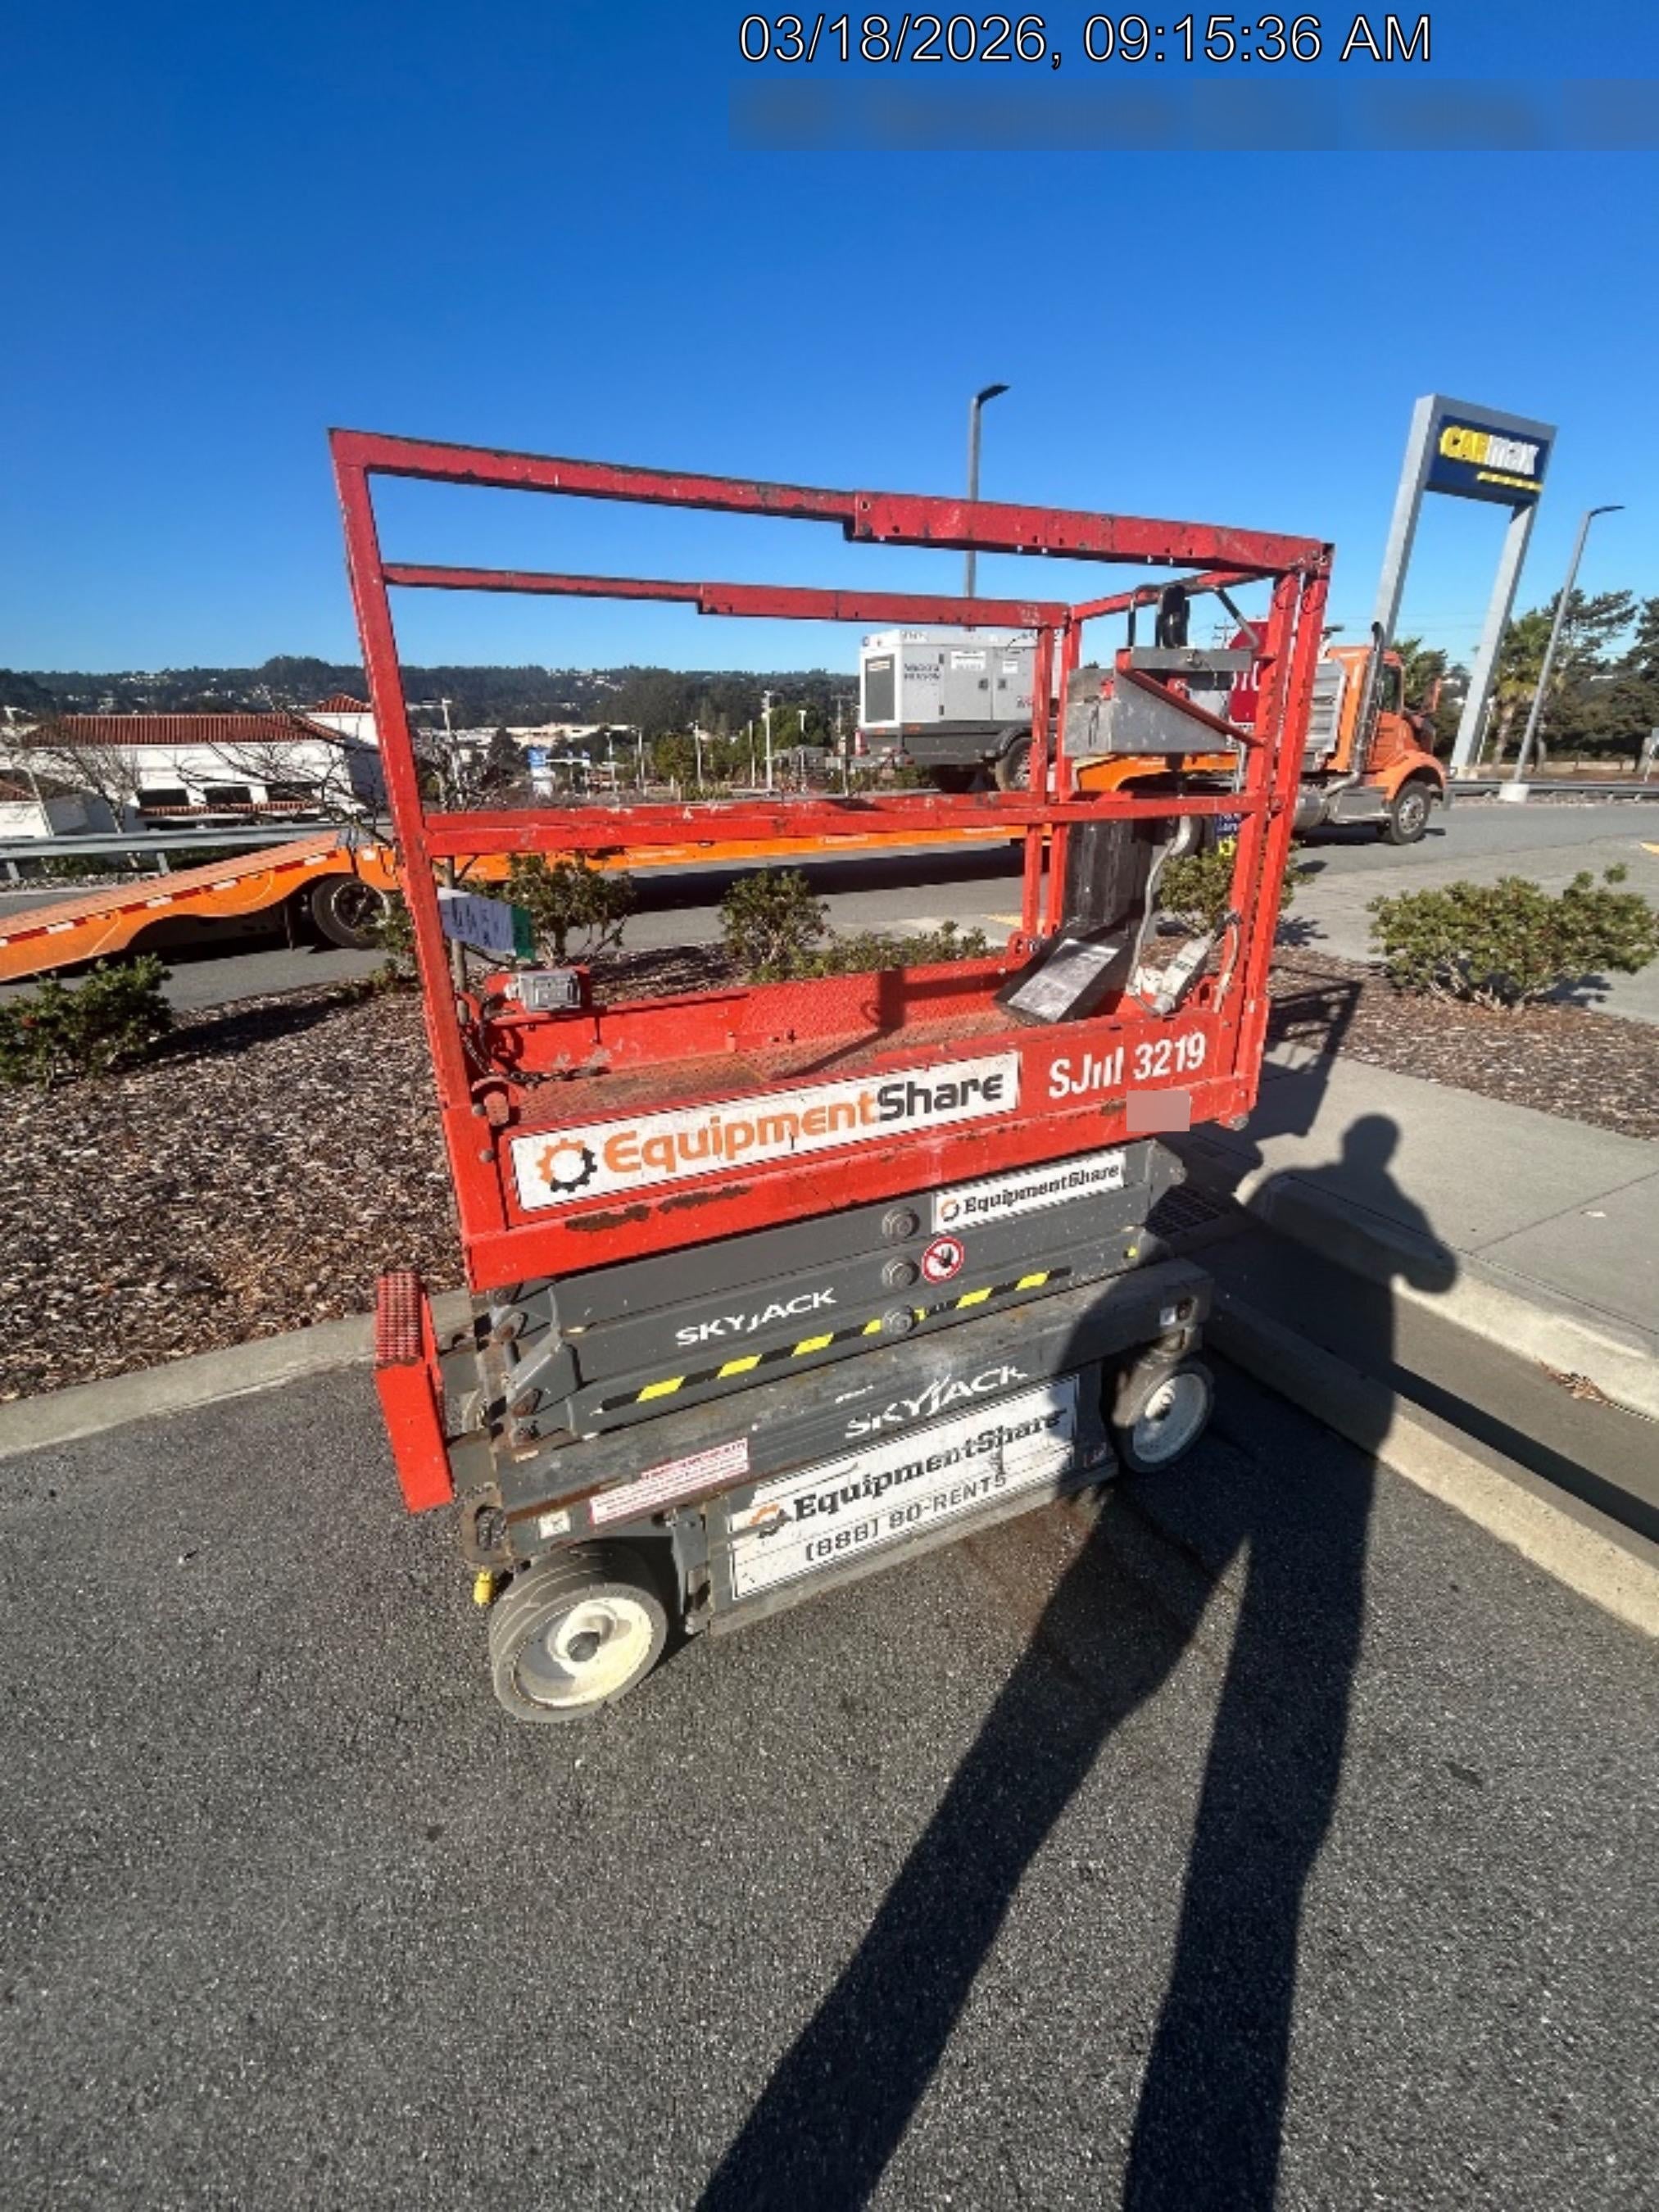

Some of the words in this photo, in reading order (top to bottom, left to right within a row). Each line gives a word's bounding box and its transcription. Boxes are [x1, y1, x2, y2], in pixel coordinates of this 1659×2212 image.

[1133, 1031, 1206, 1081] 3219
[602, 1072, 1004, 1174] EquipmentShare
[963, 1164, 1120, 1214] EquipmentShare
[675, 1287, 837, 1347] SKYJACK
[845, 1364, 1028, 1439] SKYJACK
[792, 1407, 1067, 1522] EquipmentShare
